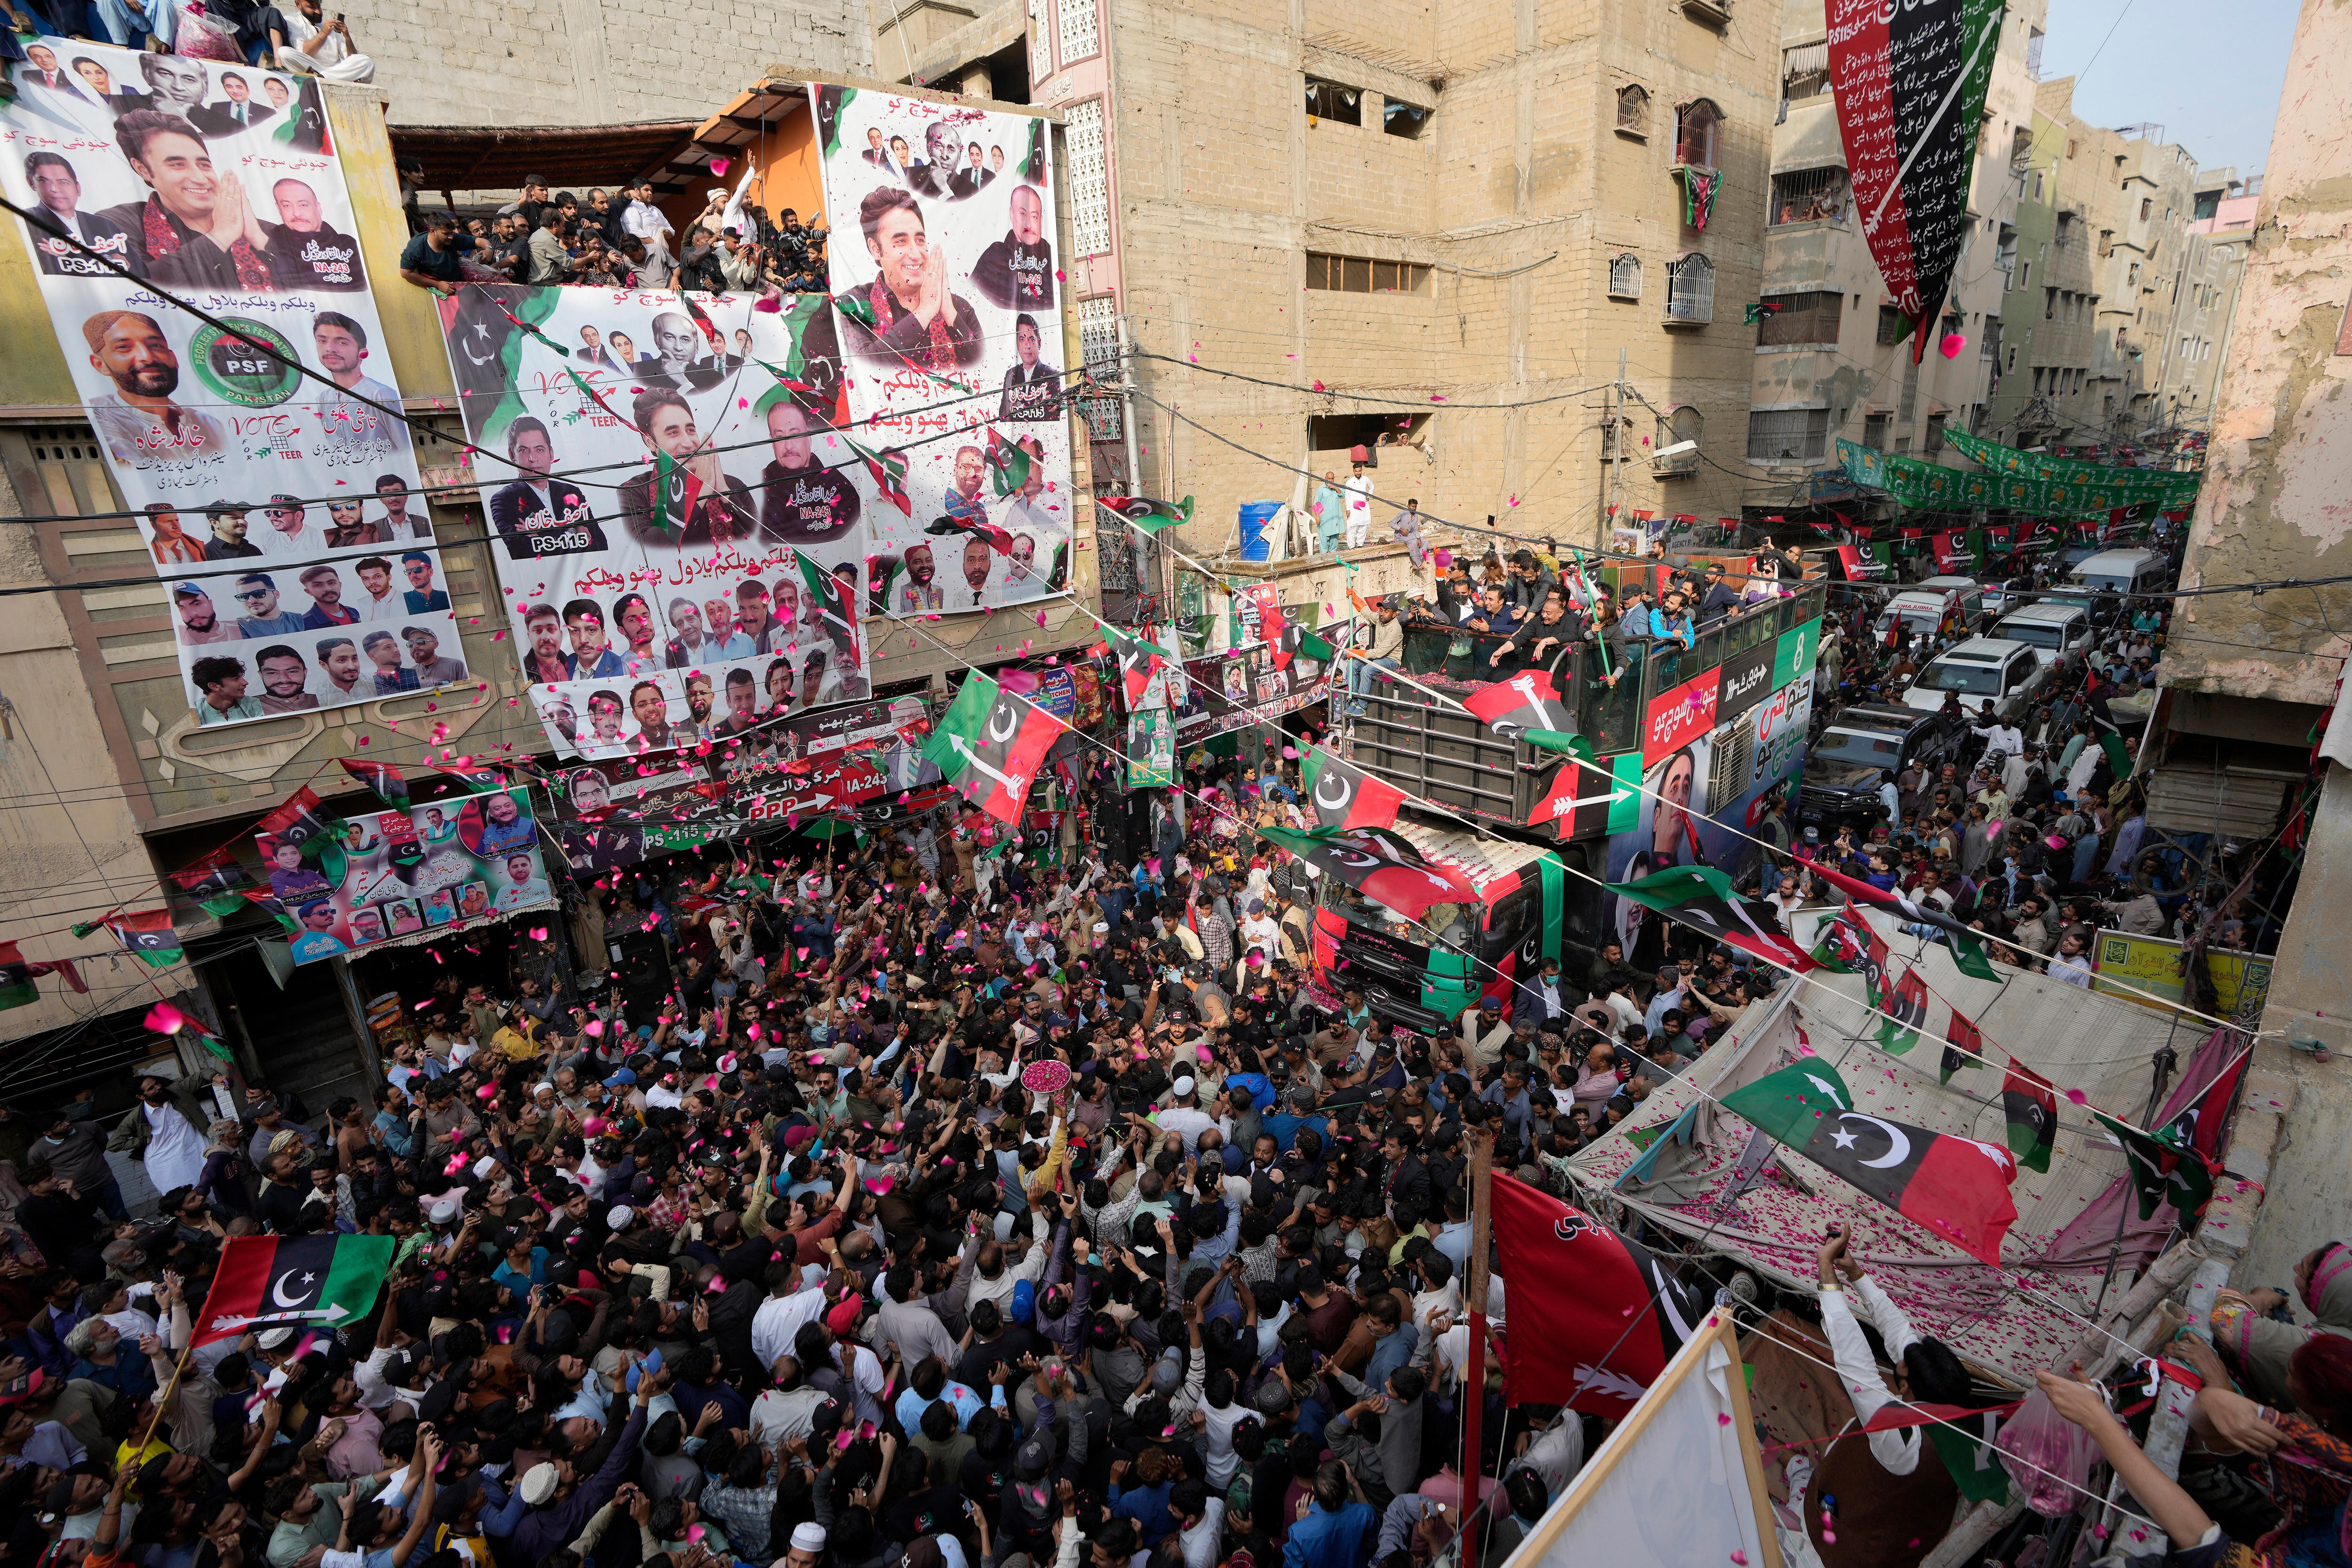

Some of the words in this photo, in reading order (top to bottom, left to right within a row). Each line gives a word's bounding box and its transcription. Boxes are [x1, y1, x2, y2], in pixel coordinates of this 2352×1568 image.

[1828, 24, 1852, 46] PS115
[889, 98, 904, 113] کو
[1900, 96, 1919, 116] حسین
[1921, 90, 1939, 112] غلام
[1905, 118, 1914, 135] علی
[4, 131, 19, 142] کو
[25, 135, 57, 147] سوچ
[63, 136, 85, 150] نئی
[1874, 144, 1891, 160] حسین
[242, 154, 255, 166] کو
[260, 159, 285, 167] سوچ
[289, 159, 307, 169] نئی
[314, 263, 350, 273] NA-243
[1018, 271, 1042, 285] NA-243
[125, 291, 166, 309] ویلکم
[202, 295, 238, 310] بلاول
[240, 296, 277, 311] ویلکم
[281, 297, 316, 312] ویلکم
[613, 290, 633, 305] کو
[639, 294, 676, 306] سوچ
[226, 360, 268, 373] PSF
[883, 370, 929, 398] ویلکم
[229, 415, 293, 437] VOTE
[590, 416, 618, 427] TEER
[136, 425, 166, 449] شاہ
[166, 422, 206, 448] خالد
[279, 451, 303, 459] TEER
[184, 473, 218, 488] ڈسٹرکٹ
[525, 508, 552, 531] خان
[554, 501, 589, 526] آصف
[800, 506, 831, 519] NA-243
[532, 533, 588, 551] PS-115
[1050, 689, 1070, 698] ITCHEN
[1653, 713, 1667, 742] کو
[1664, 701, 1686, 743] سوچ
[1772, 719, 1806, 778] سوچ
[1755, 738, 1776, 780] کو
[750, 798, 796, 824] PPP
[390, 824, 401, 832] چلے
[645, 834, 664, 849] PS
[668, 824, 699, 842] -115
[418, 866, 434, 880] پارٹی
[448, 859, 472, 873] پاکستان
[298, 880, 318, 891] آصف
[354, 871, 369, 893] تیر
[385, 884, 402, 895] انتخابی
[283, 886, 298, 896] خان
[369, 888, 384, 899] نشان
[2128, 952, 2164, 968] القرآن
